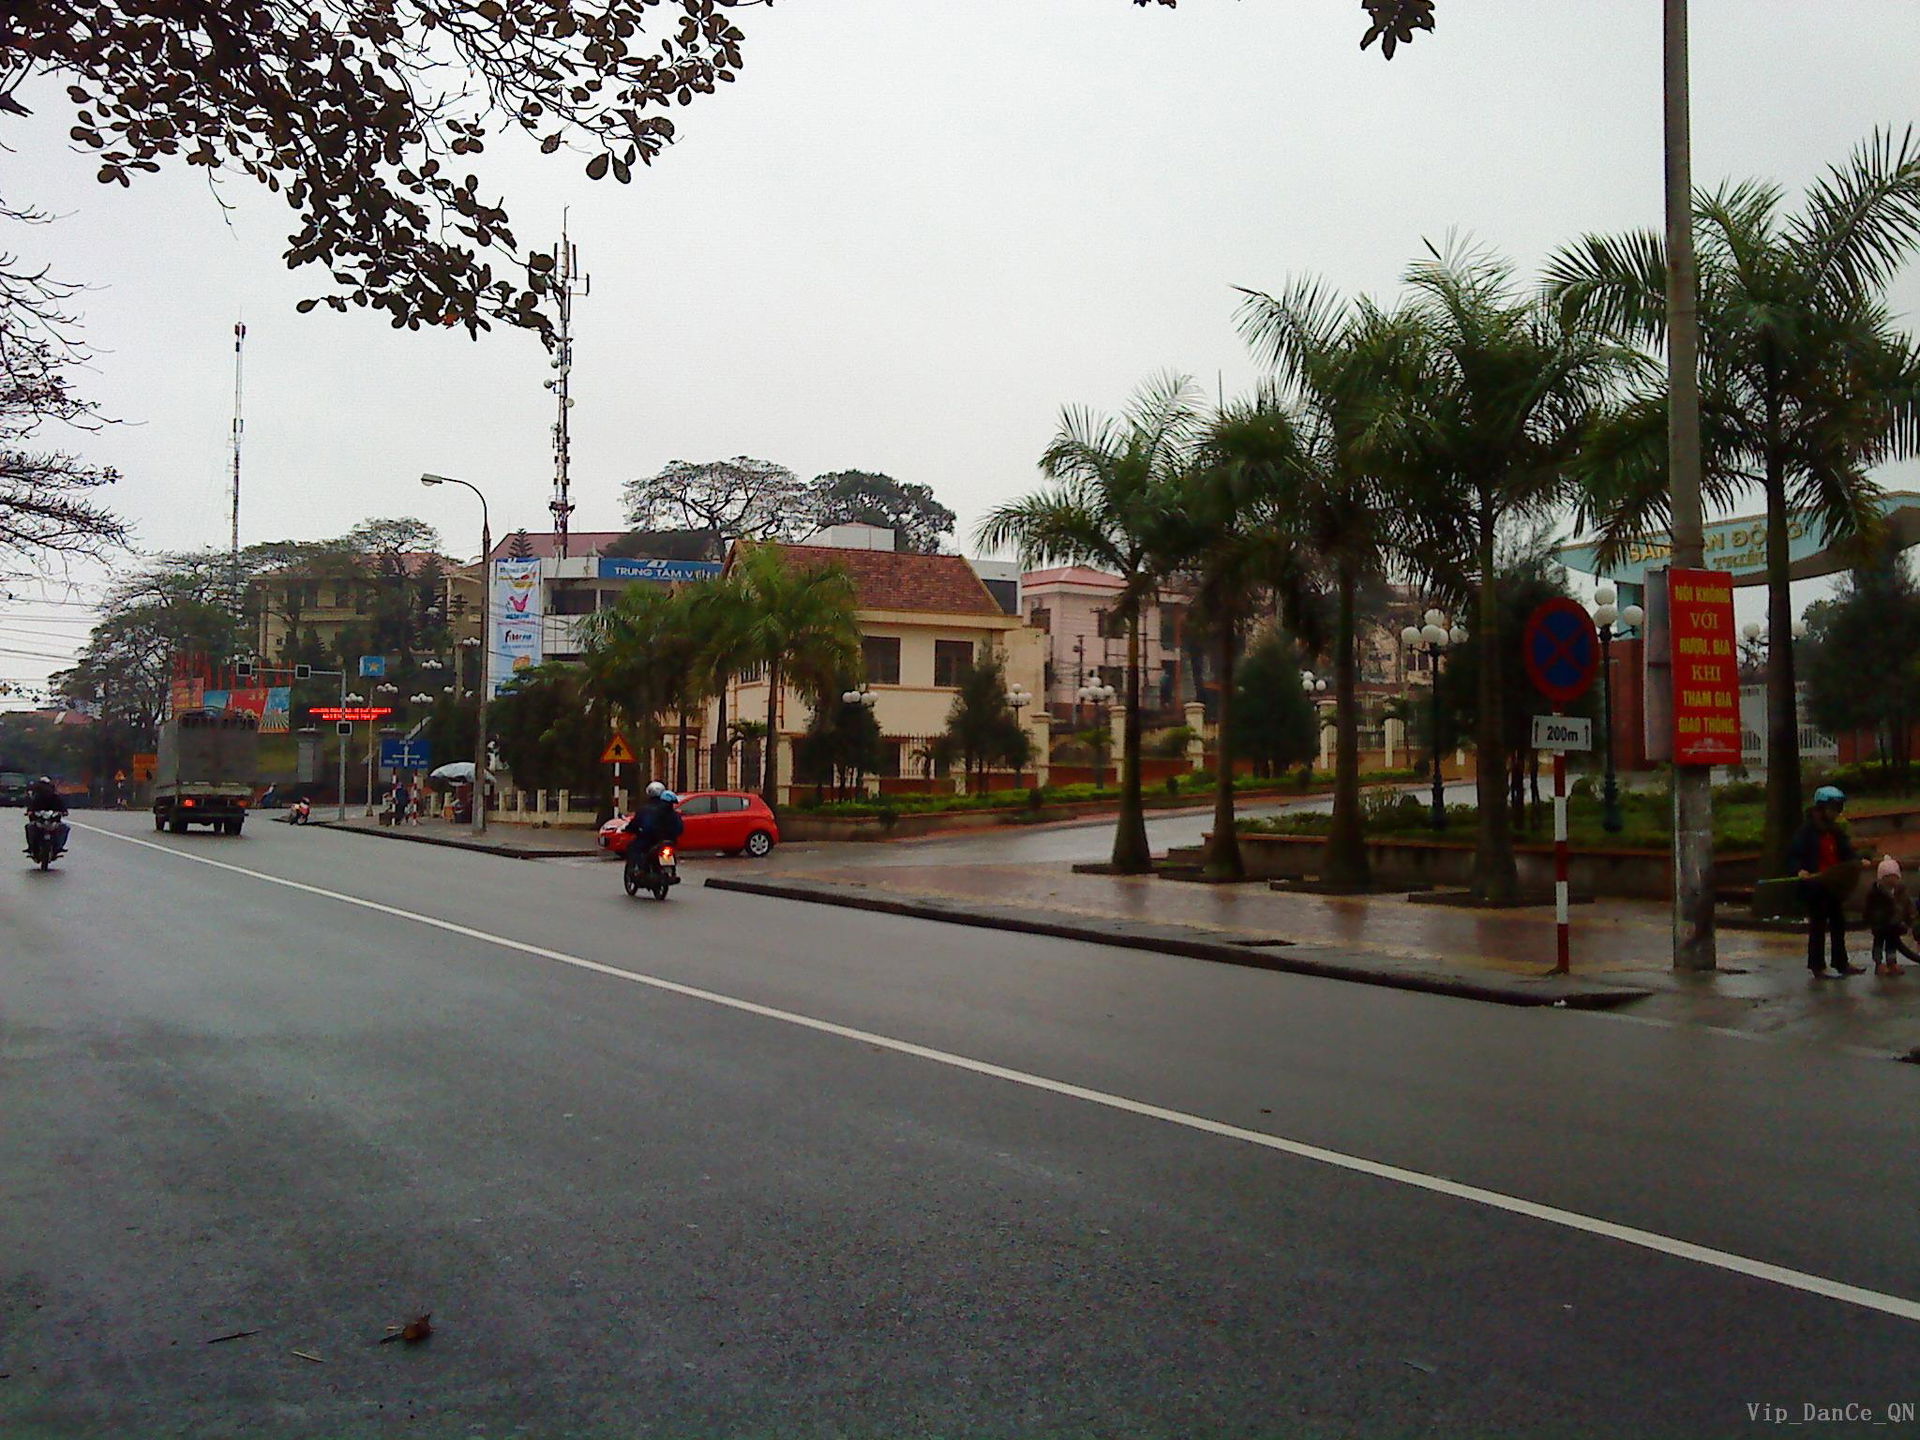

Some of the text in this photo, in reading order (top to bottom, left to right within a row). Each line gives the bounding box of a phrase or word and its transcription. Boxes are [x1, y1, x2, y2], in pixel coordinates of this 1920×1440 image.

[1731, 520, 1802, 550] ĐỘG
[615, 566, 653, 577] TRUNG
[1690, 608, 1718, 629] VỚI
[1692, 665, 1721, 681] KHI
[1683, 690, 1732, 707] THAM GIA
[1679, 716, 1701, 732] GIAO
[1547, 725, 1578, 742] 200m
